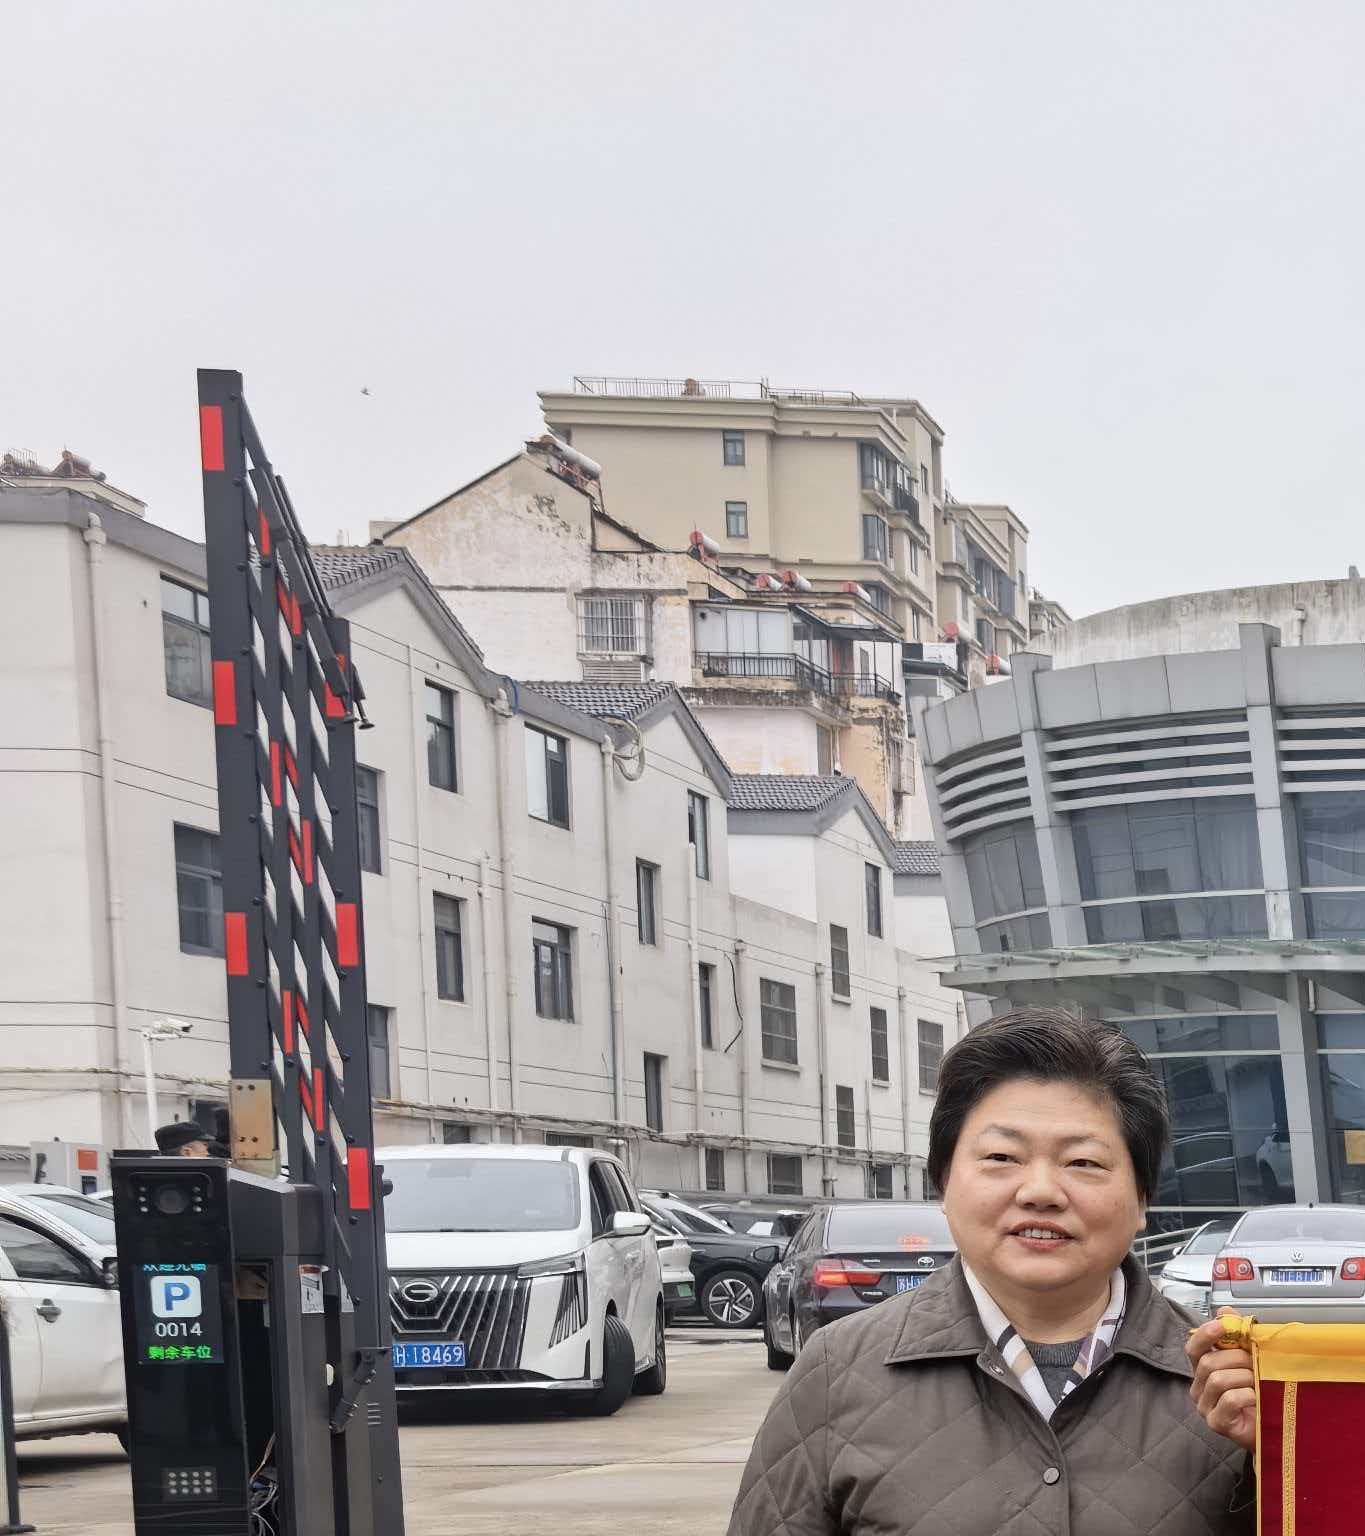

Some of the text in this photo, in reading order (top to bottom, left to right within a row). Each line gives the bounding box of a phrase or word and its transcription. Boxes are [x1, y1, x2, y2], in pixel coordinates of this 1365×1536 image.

[164, 1282, 192, 1311] P
[155, 1323, 202, 1337] 0014
[147, 1346, 213, 1360] 剩余车位
